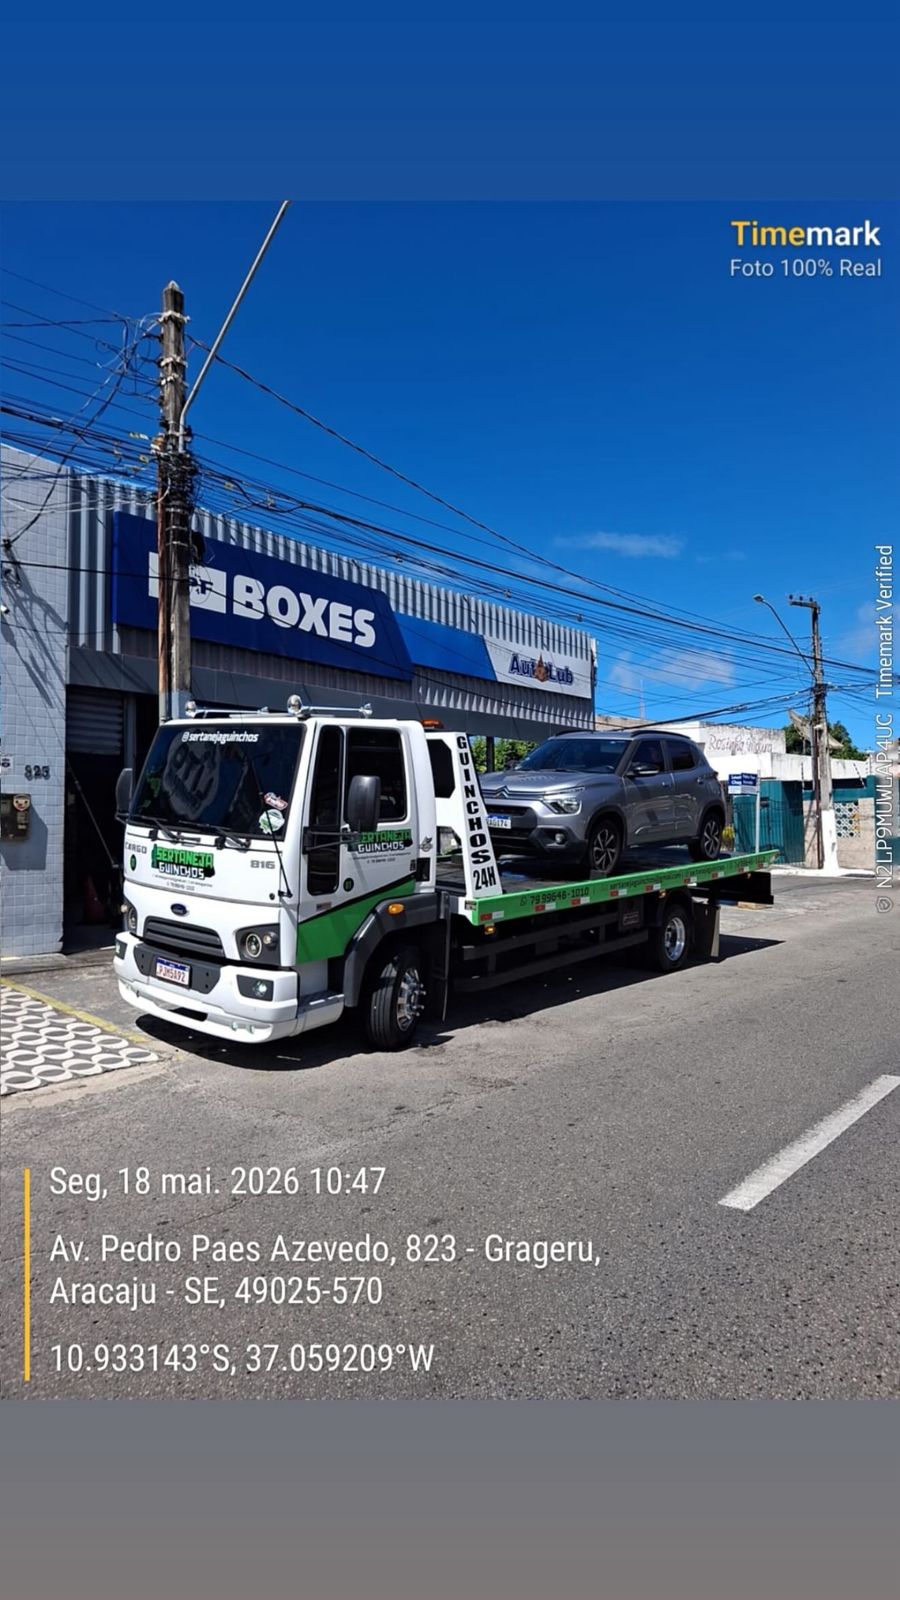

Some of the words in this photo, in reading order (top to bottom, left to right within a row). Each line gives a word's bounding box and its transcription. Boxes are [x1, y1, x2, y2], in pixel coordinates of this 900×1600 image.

[233, 573, 376, 648] BOXES
[457, 735, 491, 865] GUINCHOS
[359, 829, 412, 843] ERTANEJA
[156, 846, 214, 868] SERTANEJA
[358, 841, 405, 854] GUINCHOS
[159, 862, 205, 880] GUINCHOS
[250, 860, 276, 870] 816
[473, 866, 497, 891] 24H
